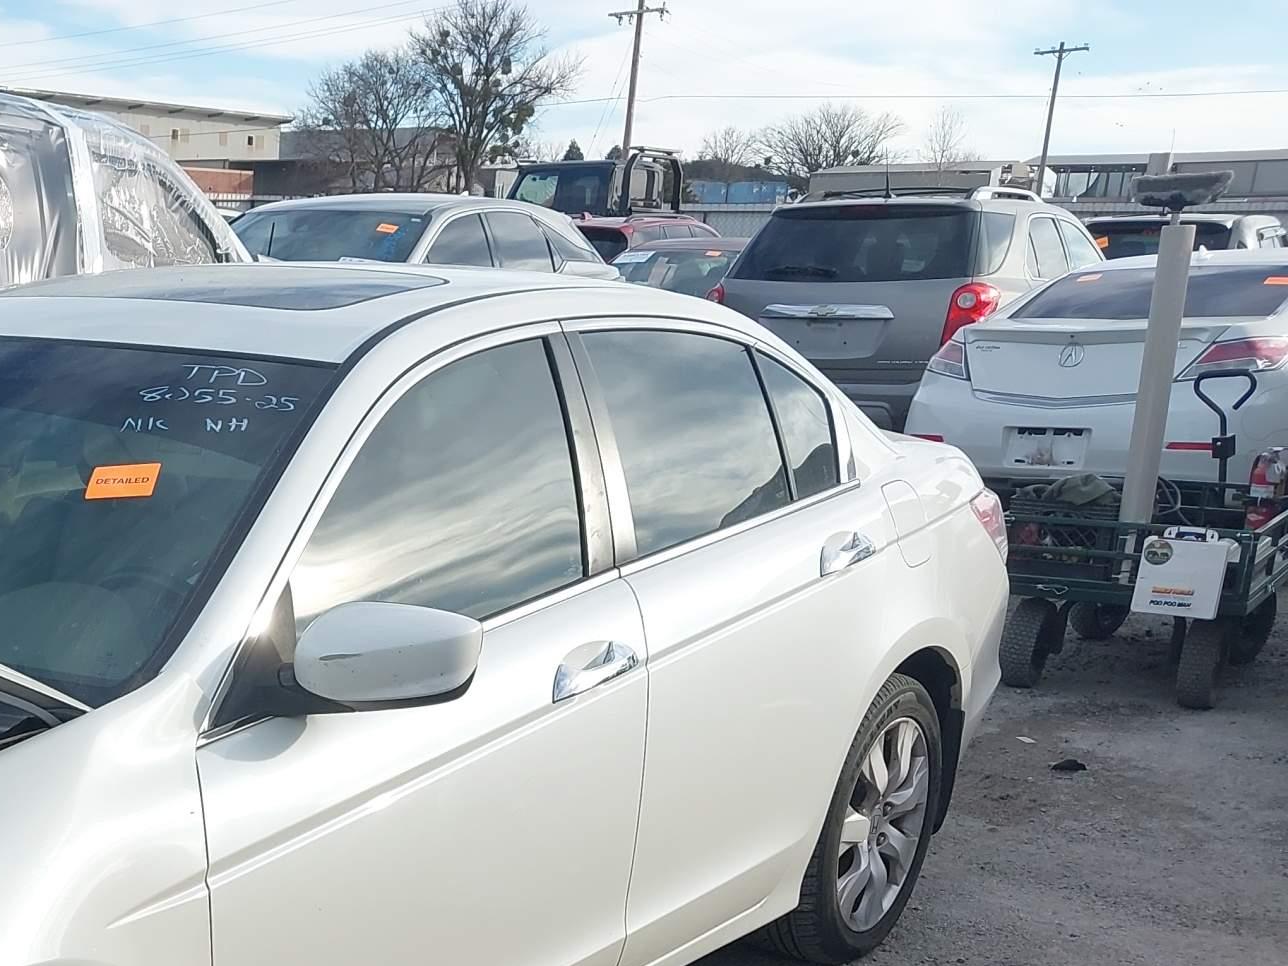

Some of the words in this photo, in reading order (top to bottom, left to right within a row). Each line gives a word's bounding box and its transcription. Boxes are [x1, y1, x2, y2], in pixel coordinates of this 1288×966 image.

[182, 364, 268, 387] TPD
[205, 417, 250, 433] NH
[95, 475, 150, 486] DETAILED
